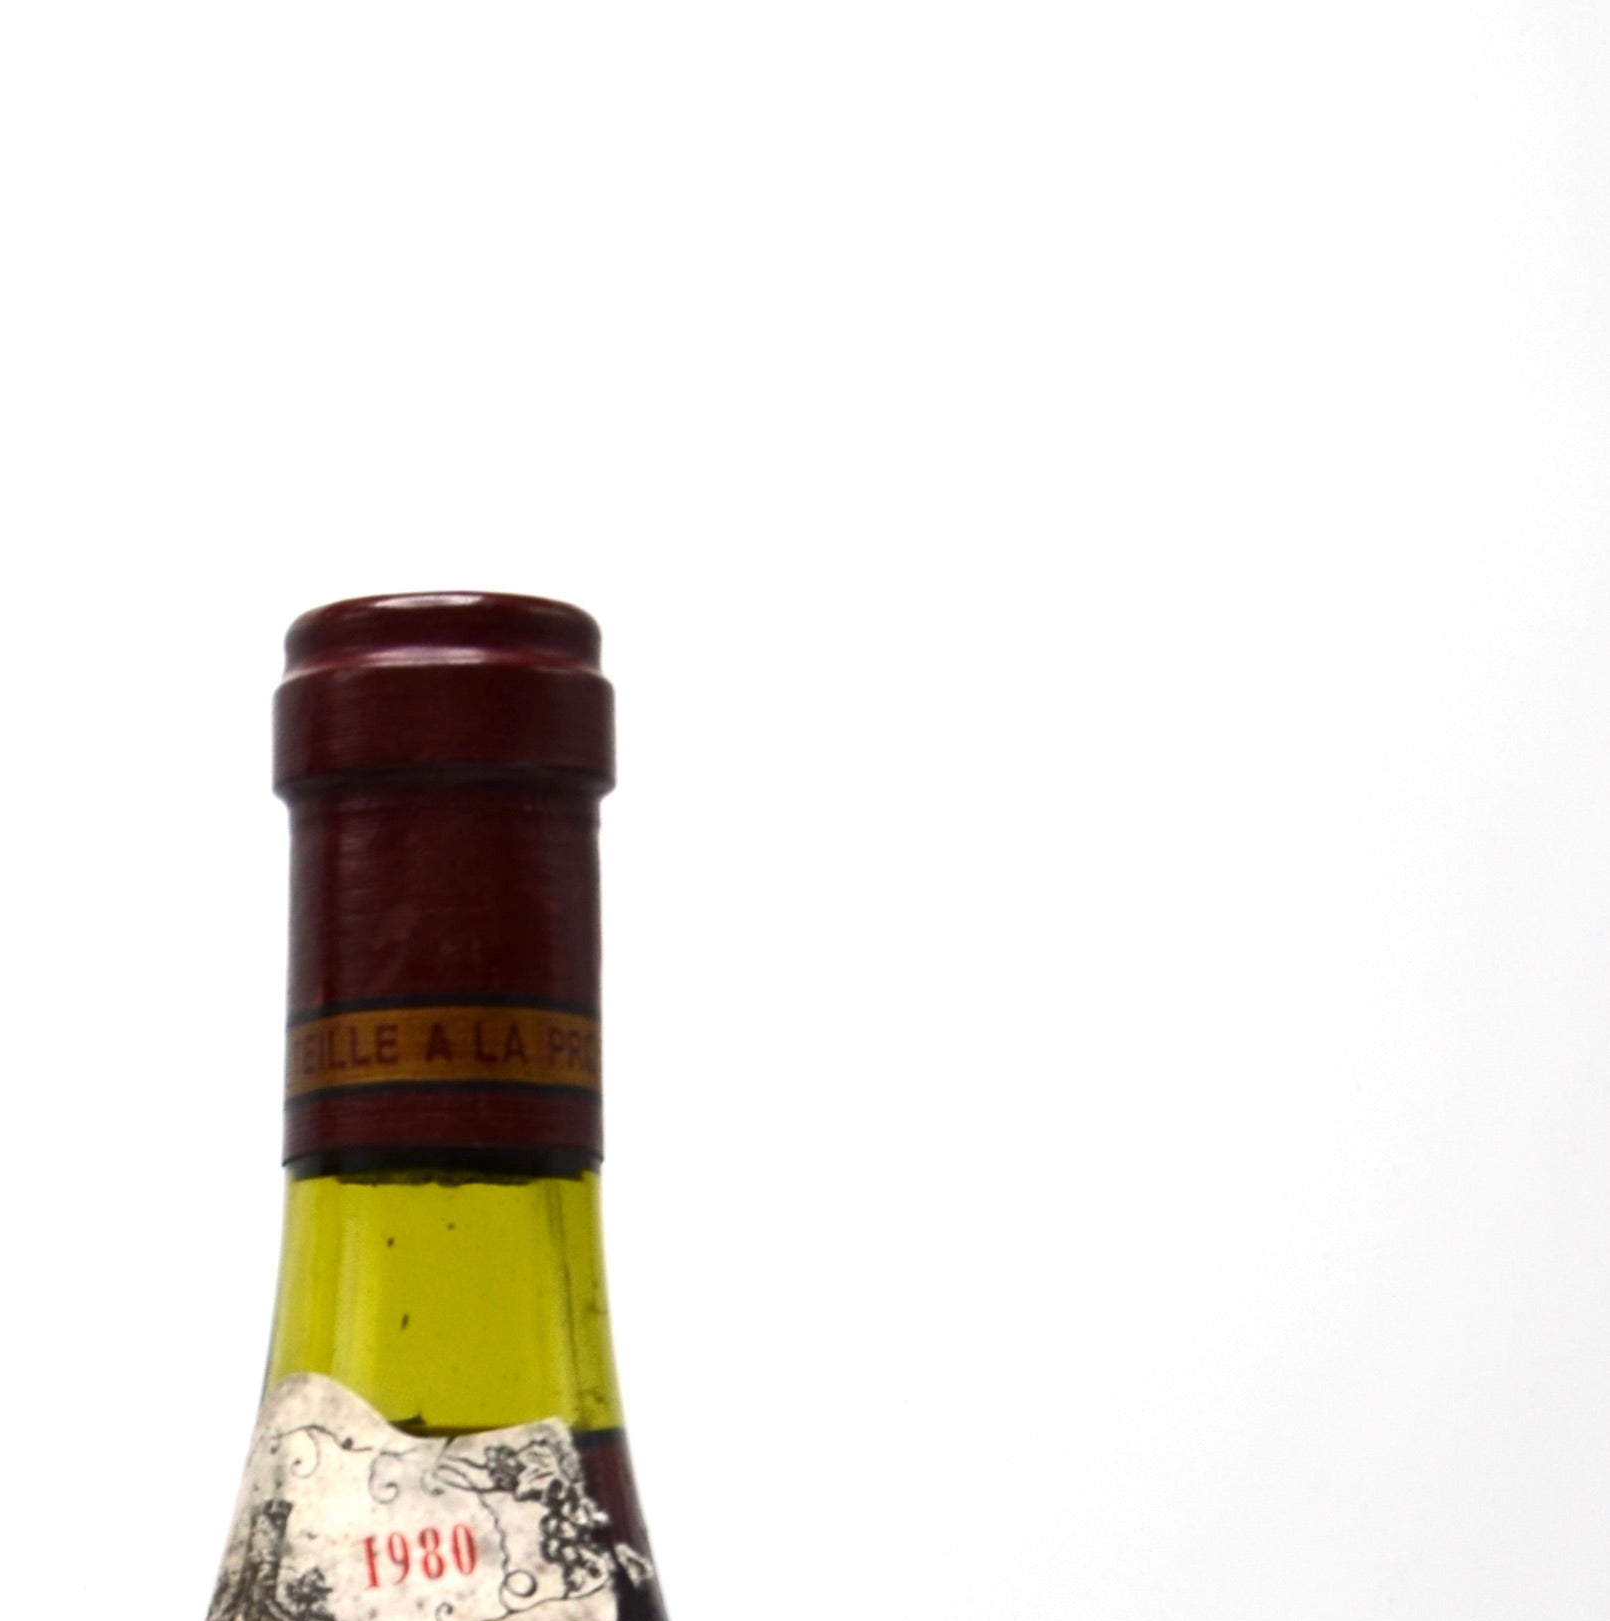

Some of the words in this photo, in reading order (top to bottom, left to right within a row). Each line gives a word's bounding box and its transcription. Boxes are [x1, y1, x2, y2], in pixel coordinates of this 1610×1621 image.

[426, 1022, 452, 1064] A
[474, 1022, 529, 1066] LA
[362, 1523, 478, 1590] 1980
